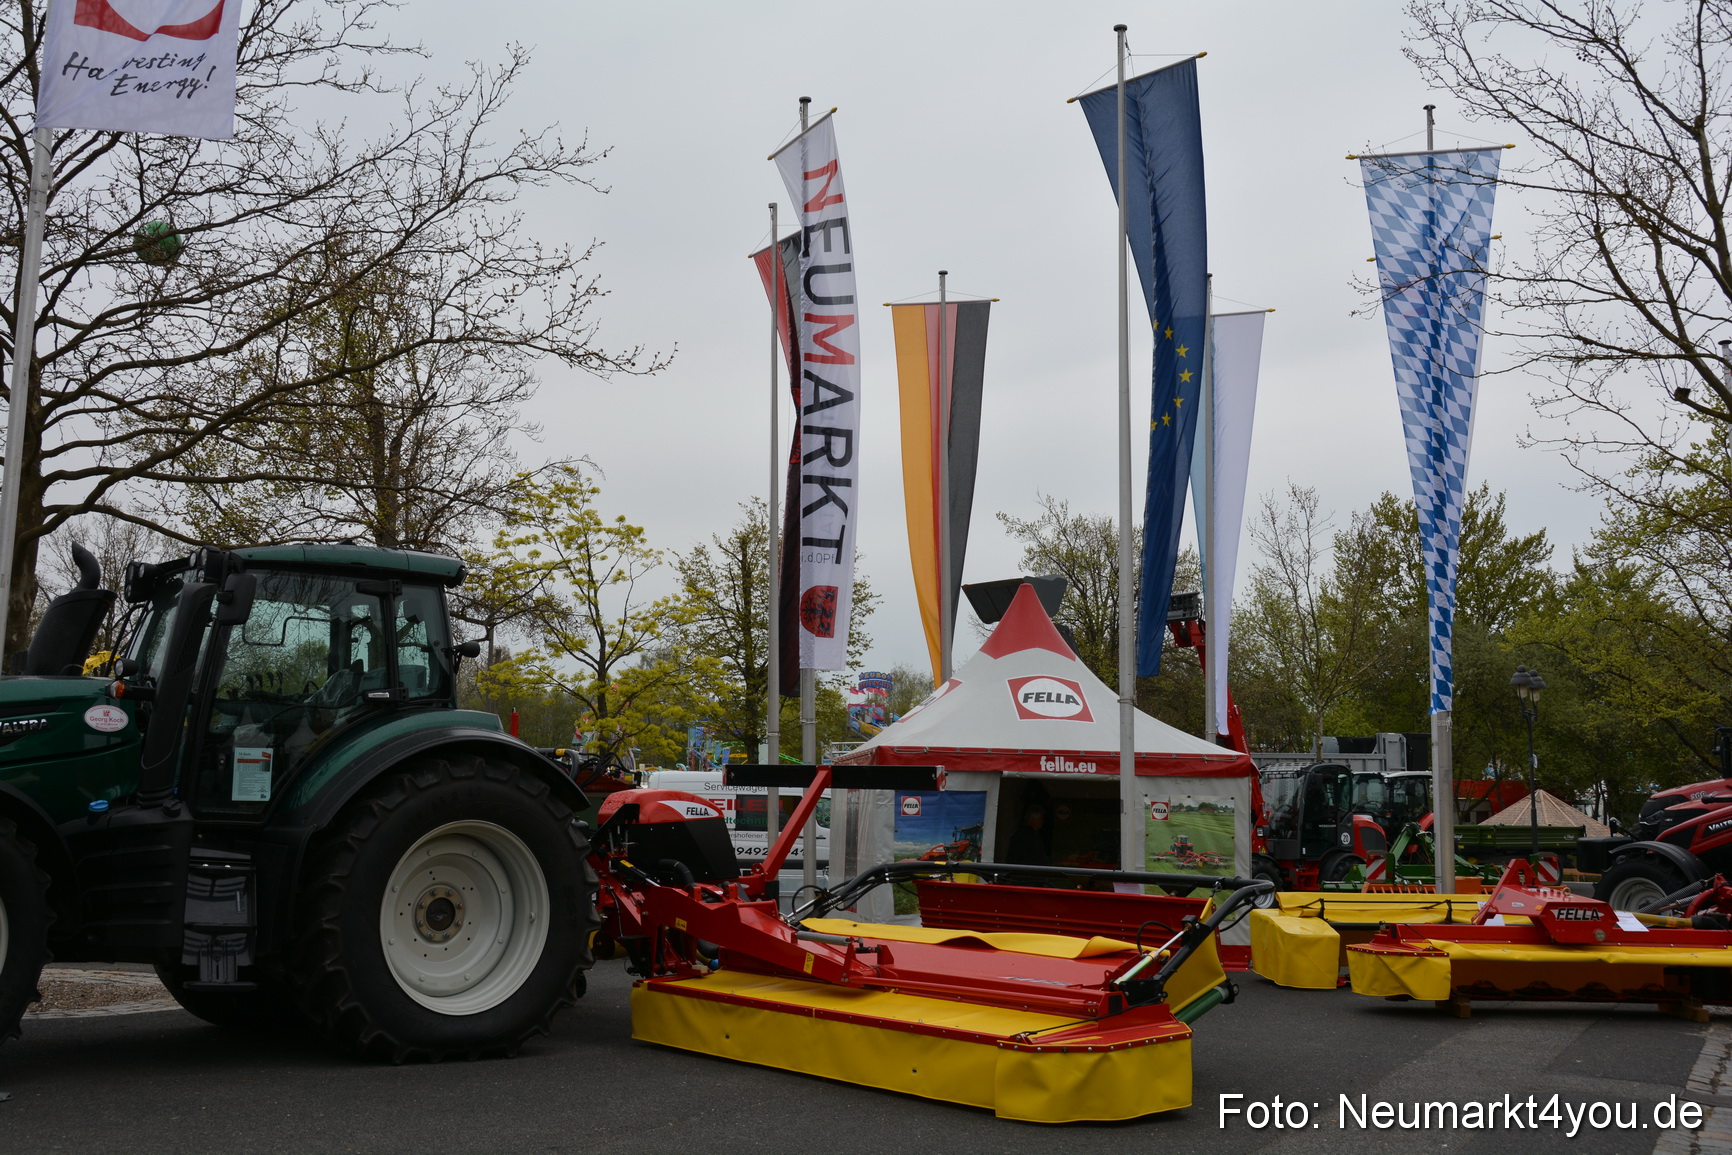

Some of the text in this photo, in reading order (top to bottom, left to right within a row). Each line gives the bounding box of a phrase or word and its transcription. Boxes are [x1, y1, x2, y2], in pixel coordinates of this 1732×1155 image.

[109, 65, 217, 99] Energy!
[803, 158, 855, 564] NEUMARKT
[1022, 691, 1081, 706] FELLA
[0, 718, 48, 734] ALTRA
[90, 715, 108, 723] Georg
[1040, 755, 1097, 773] fella.eu
[686, 806, 710, 816] FELLA
[1343, 834, 1349, 843] 20
[1556, 907, 1601, 921] FELLA
